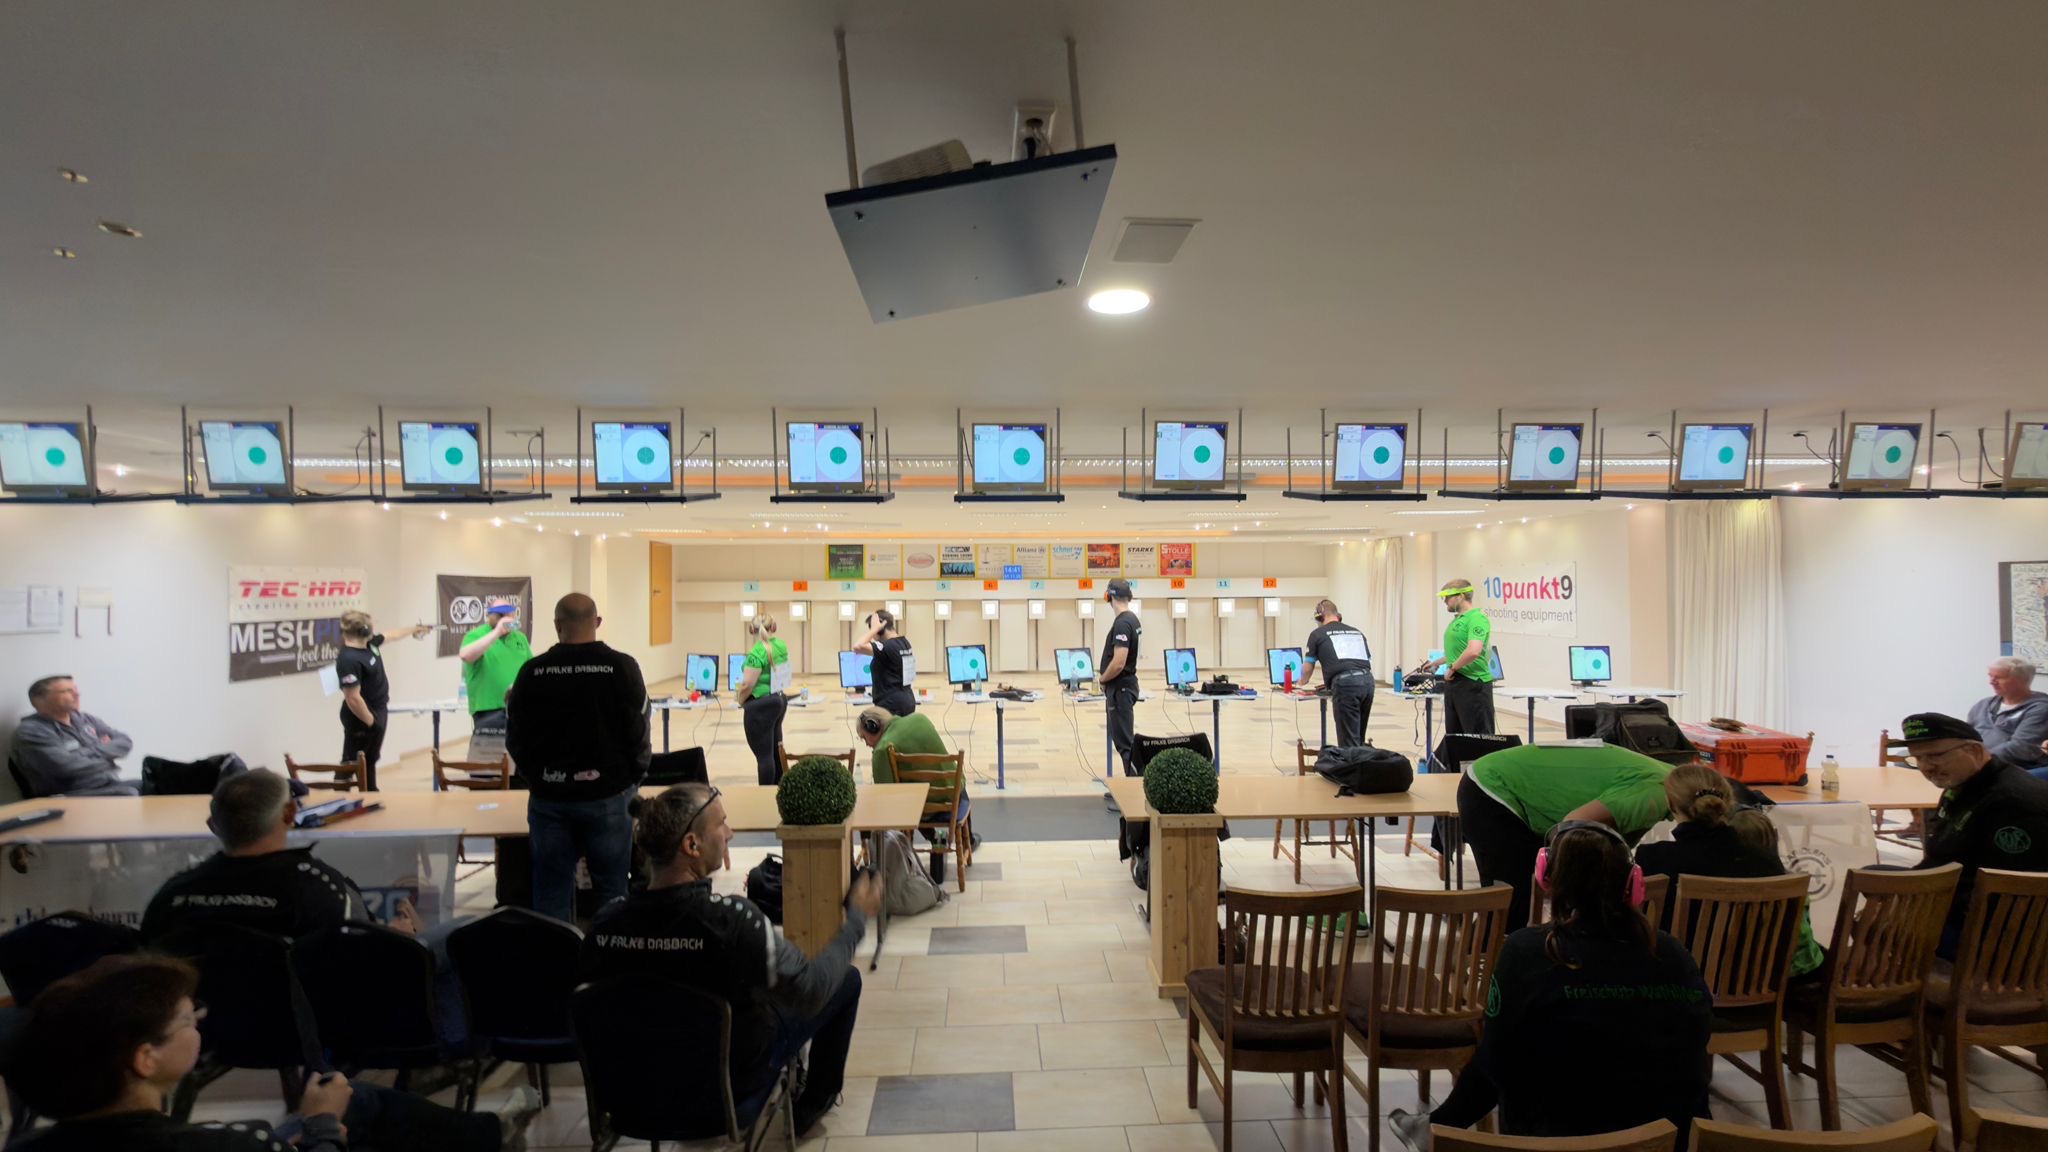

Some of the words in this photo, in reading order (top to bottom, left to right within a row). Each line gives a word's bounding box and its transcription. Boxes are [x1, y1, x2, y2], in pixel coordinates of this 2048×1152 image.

[1162, 545, 1189, 554] STOLLE
[1484, 575, 1573, 604] 10punkt9
[1485, 608, 1519, 622] shooting
[1521, 610, 1573, 623] equipment
[297, 643, 318, 672] feel
[534, 667, 544, 676] SV
[546, 666, 573, 675] FALKE
[575, 665, 614, 674] DASBACH
[610, 936, 644, 950] FALKE
[647, 938, 703, 951] DASBACH
